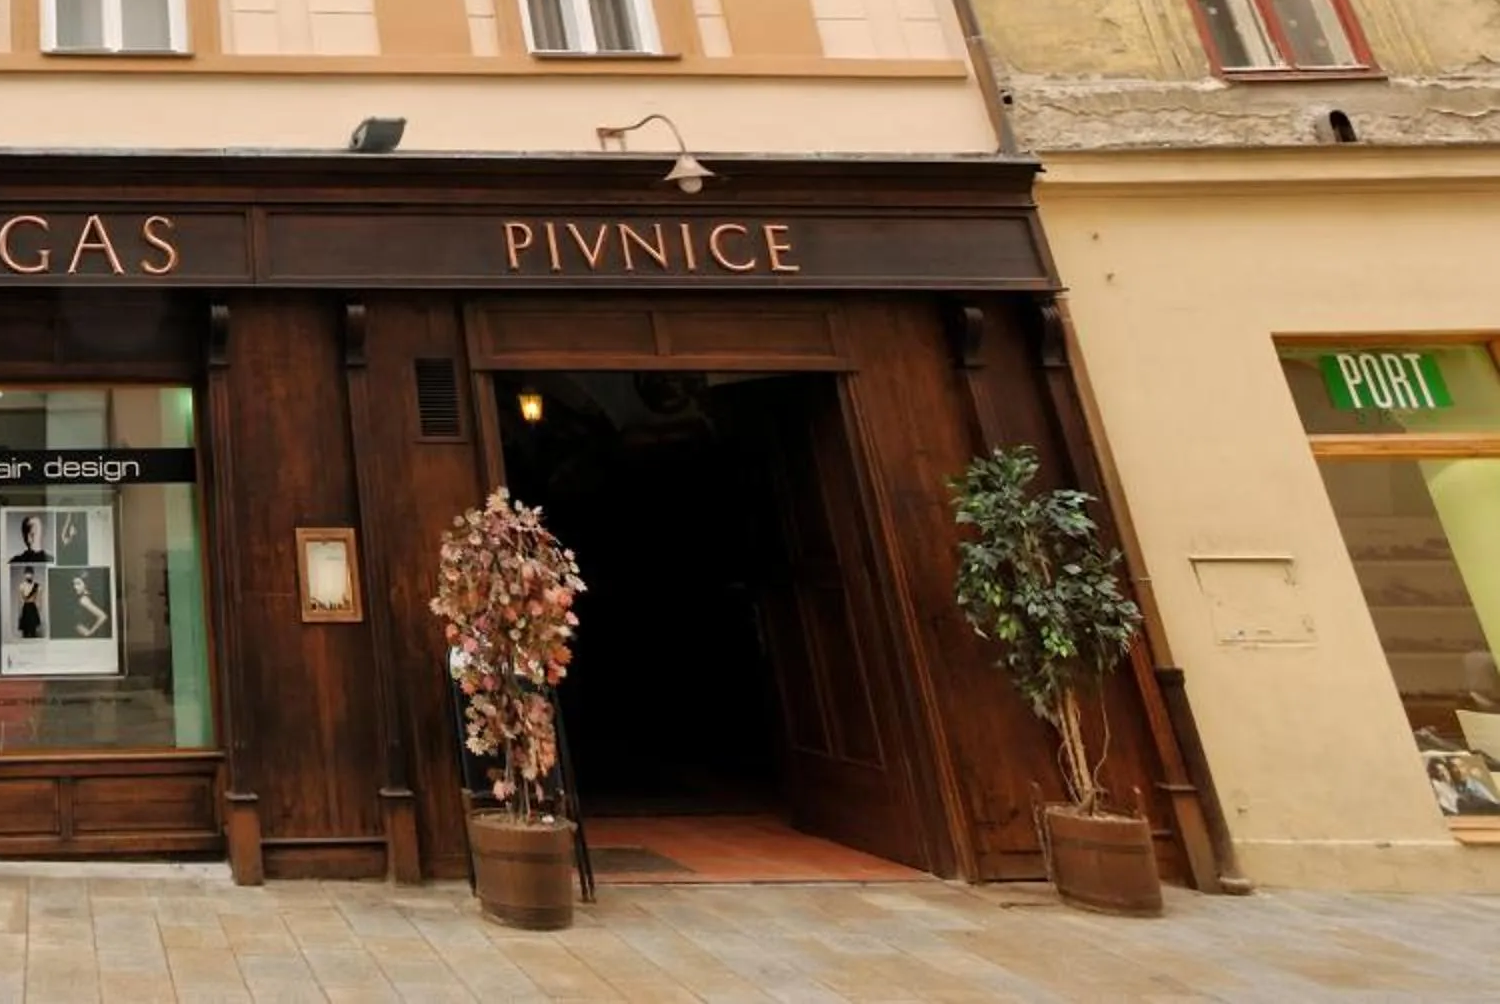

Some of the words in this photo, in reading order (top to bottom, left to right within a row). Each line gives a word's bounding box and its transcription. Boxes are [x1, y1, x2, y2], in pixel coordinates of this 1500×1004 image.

[504, 221, 800, 272] PIVNICE
[1336, 353, 1436, 409] PORT
[44, 455, 140, 483] design
